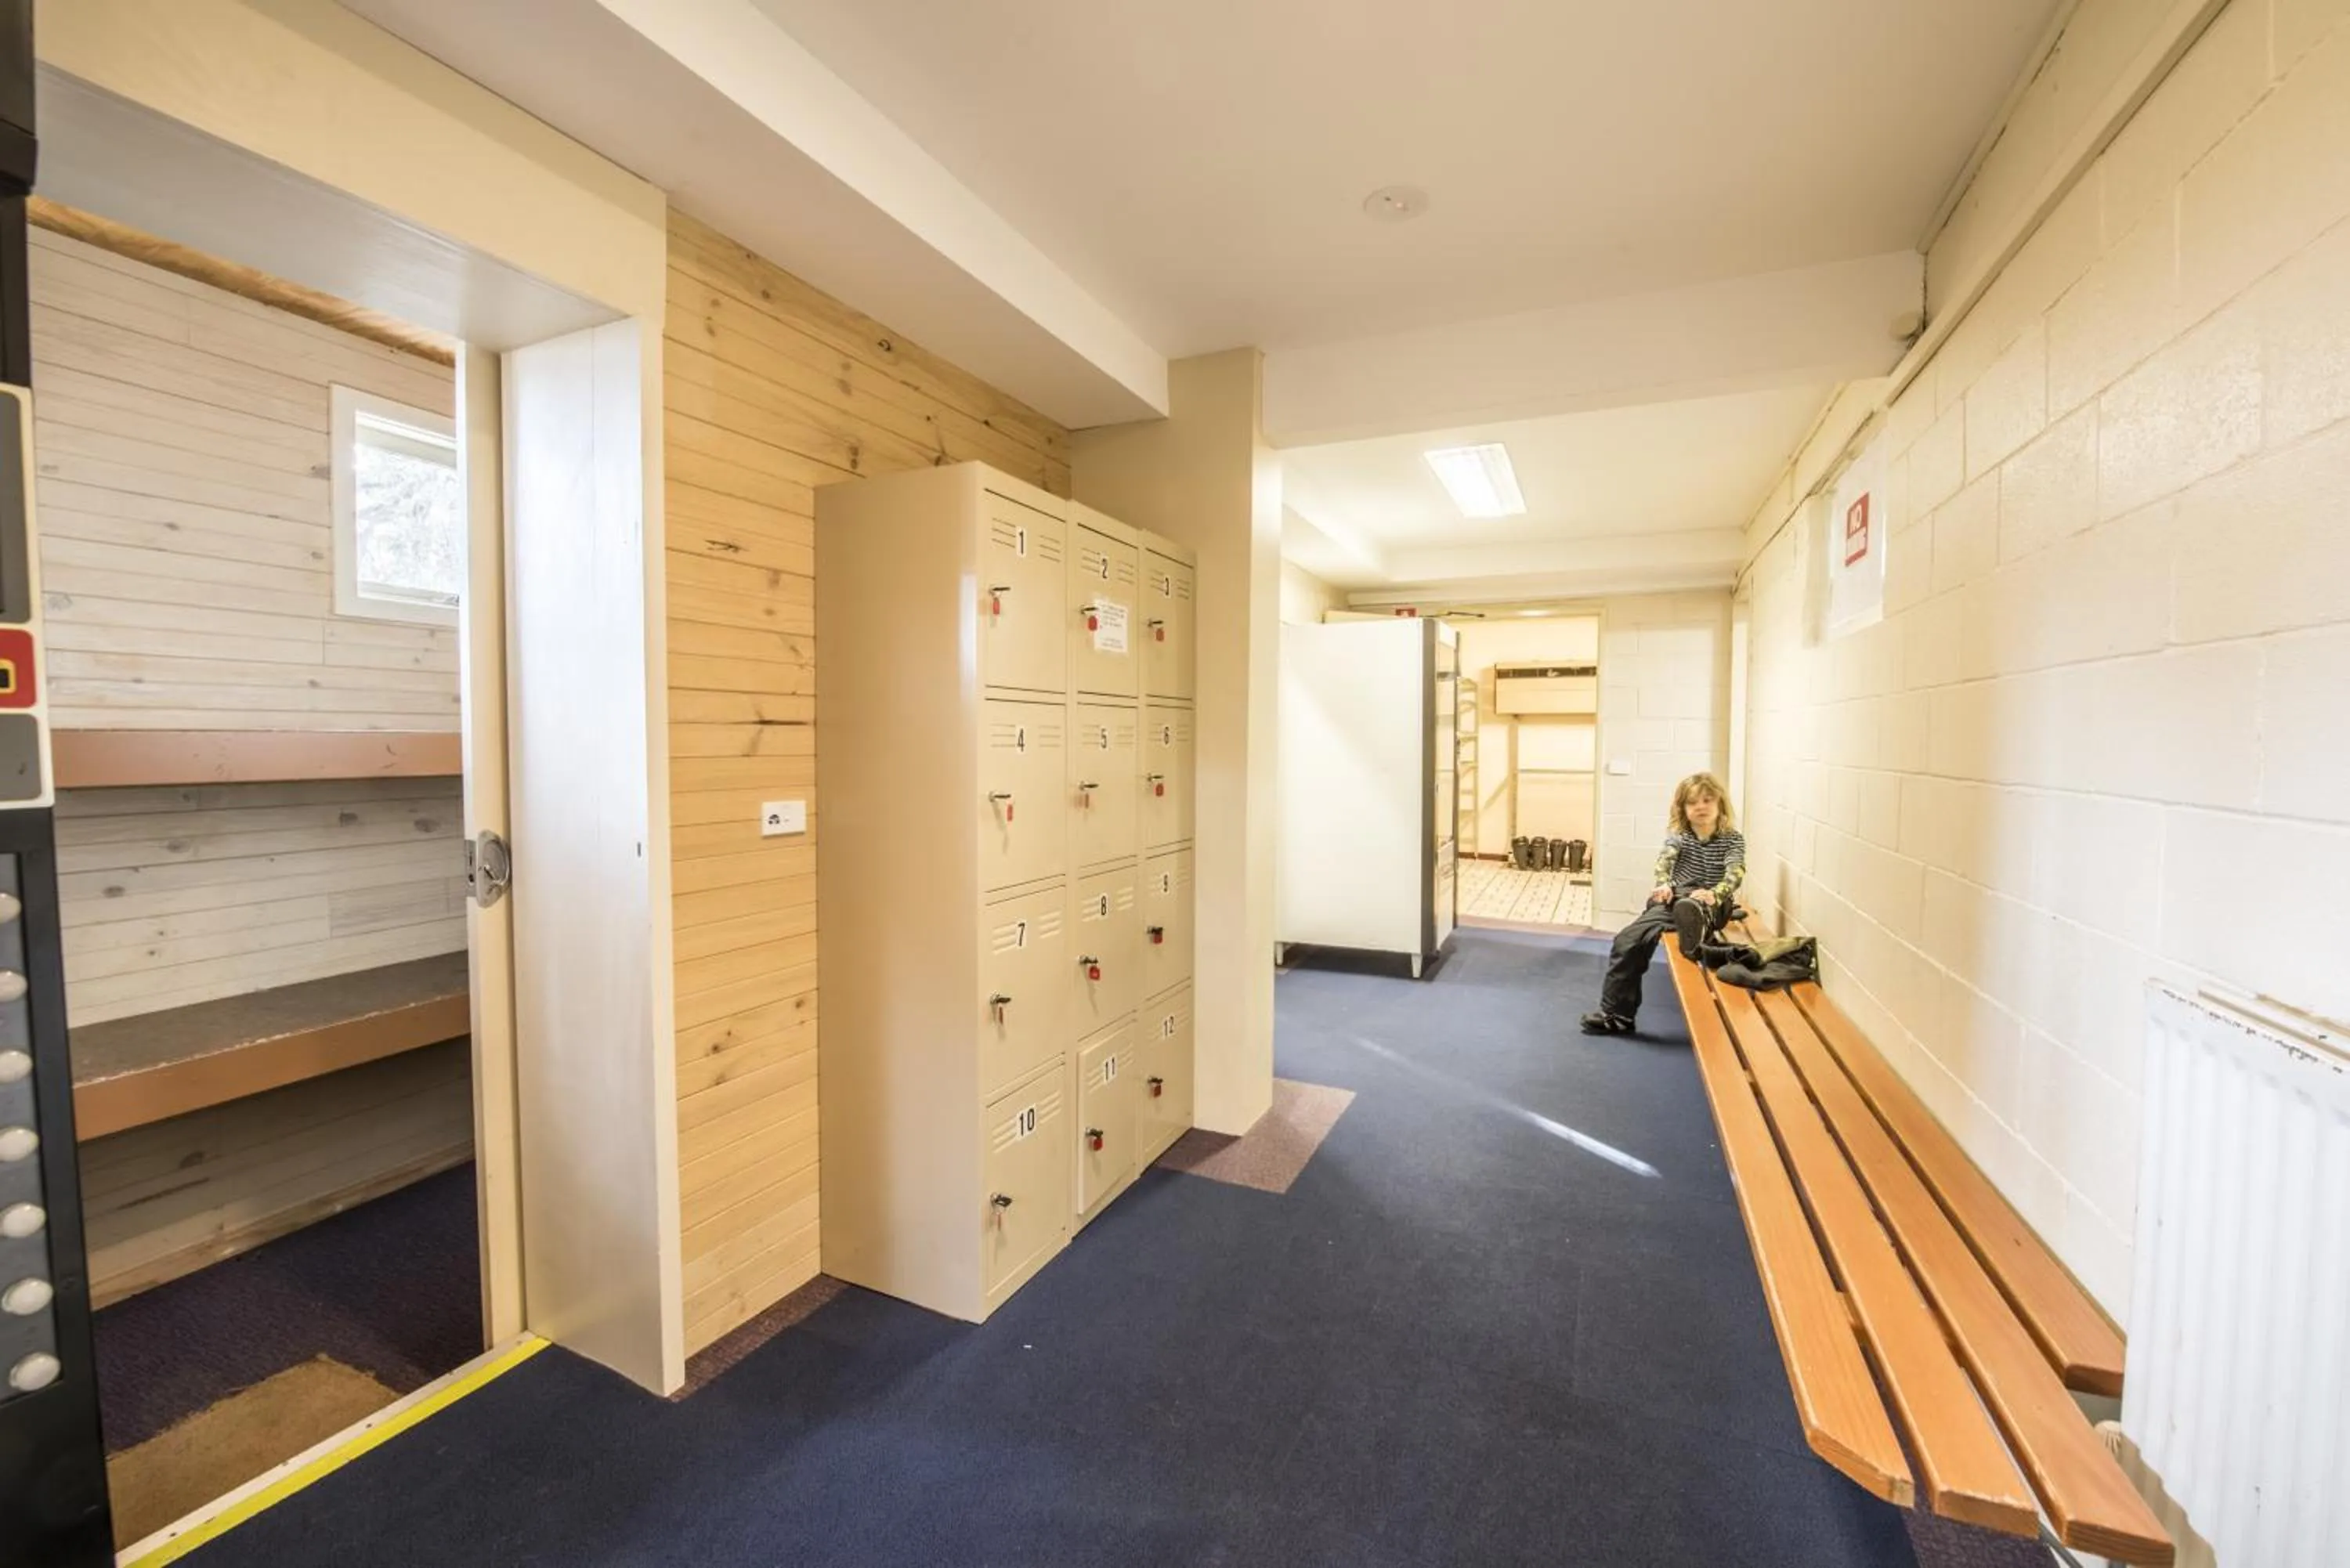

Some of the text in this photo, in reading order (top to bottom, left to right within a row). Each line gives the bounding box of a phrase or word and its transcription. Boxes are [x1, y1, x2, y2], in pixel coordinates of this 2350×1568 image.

[1018, 529, 1025, 555] 1
[1101, 558, 1108, 580] 2
[1017, 728, 1026, 752] 4
[1100, 728, 1108, 750] 5
[1163, 726, 1170, 745] 6
[1101, 895, 1107, 916] 8
[1018, 922, 1025, 947] 7
[1163, 1015, 1176, 1037] 12
[1104, 1056, 1116, 1082] 11
[1019, 1107, 1036, 1136] 10
